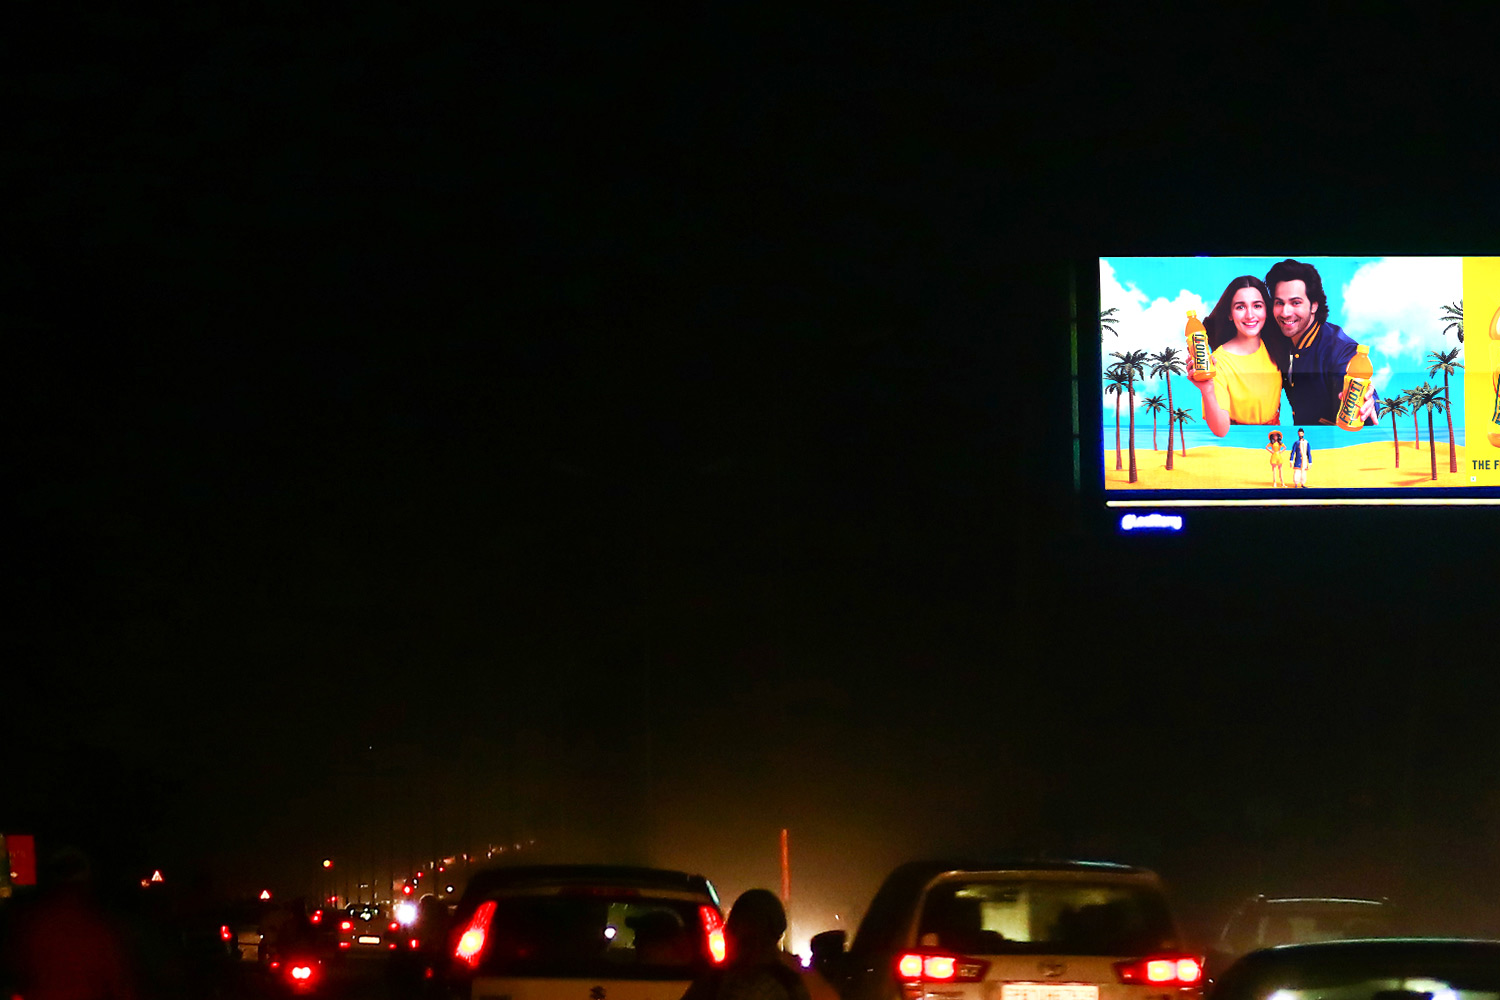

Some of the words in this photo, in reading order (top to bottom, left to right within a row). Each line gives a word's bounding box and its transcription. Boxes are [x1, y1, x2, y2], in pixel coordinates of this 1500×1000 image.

[1195, 334, 1206, 371] FROOTI
[1339, 380, 1363, 424] FROOTI
[1472, 459, 1491, 470] THE
